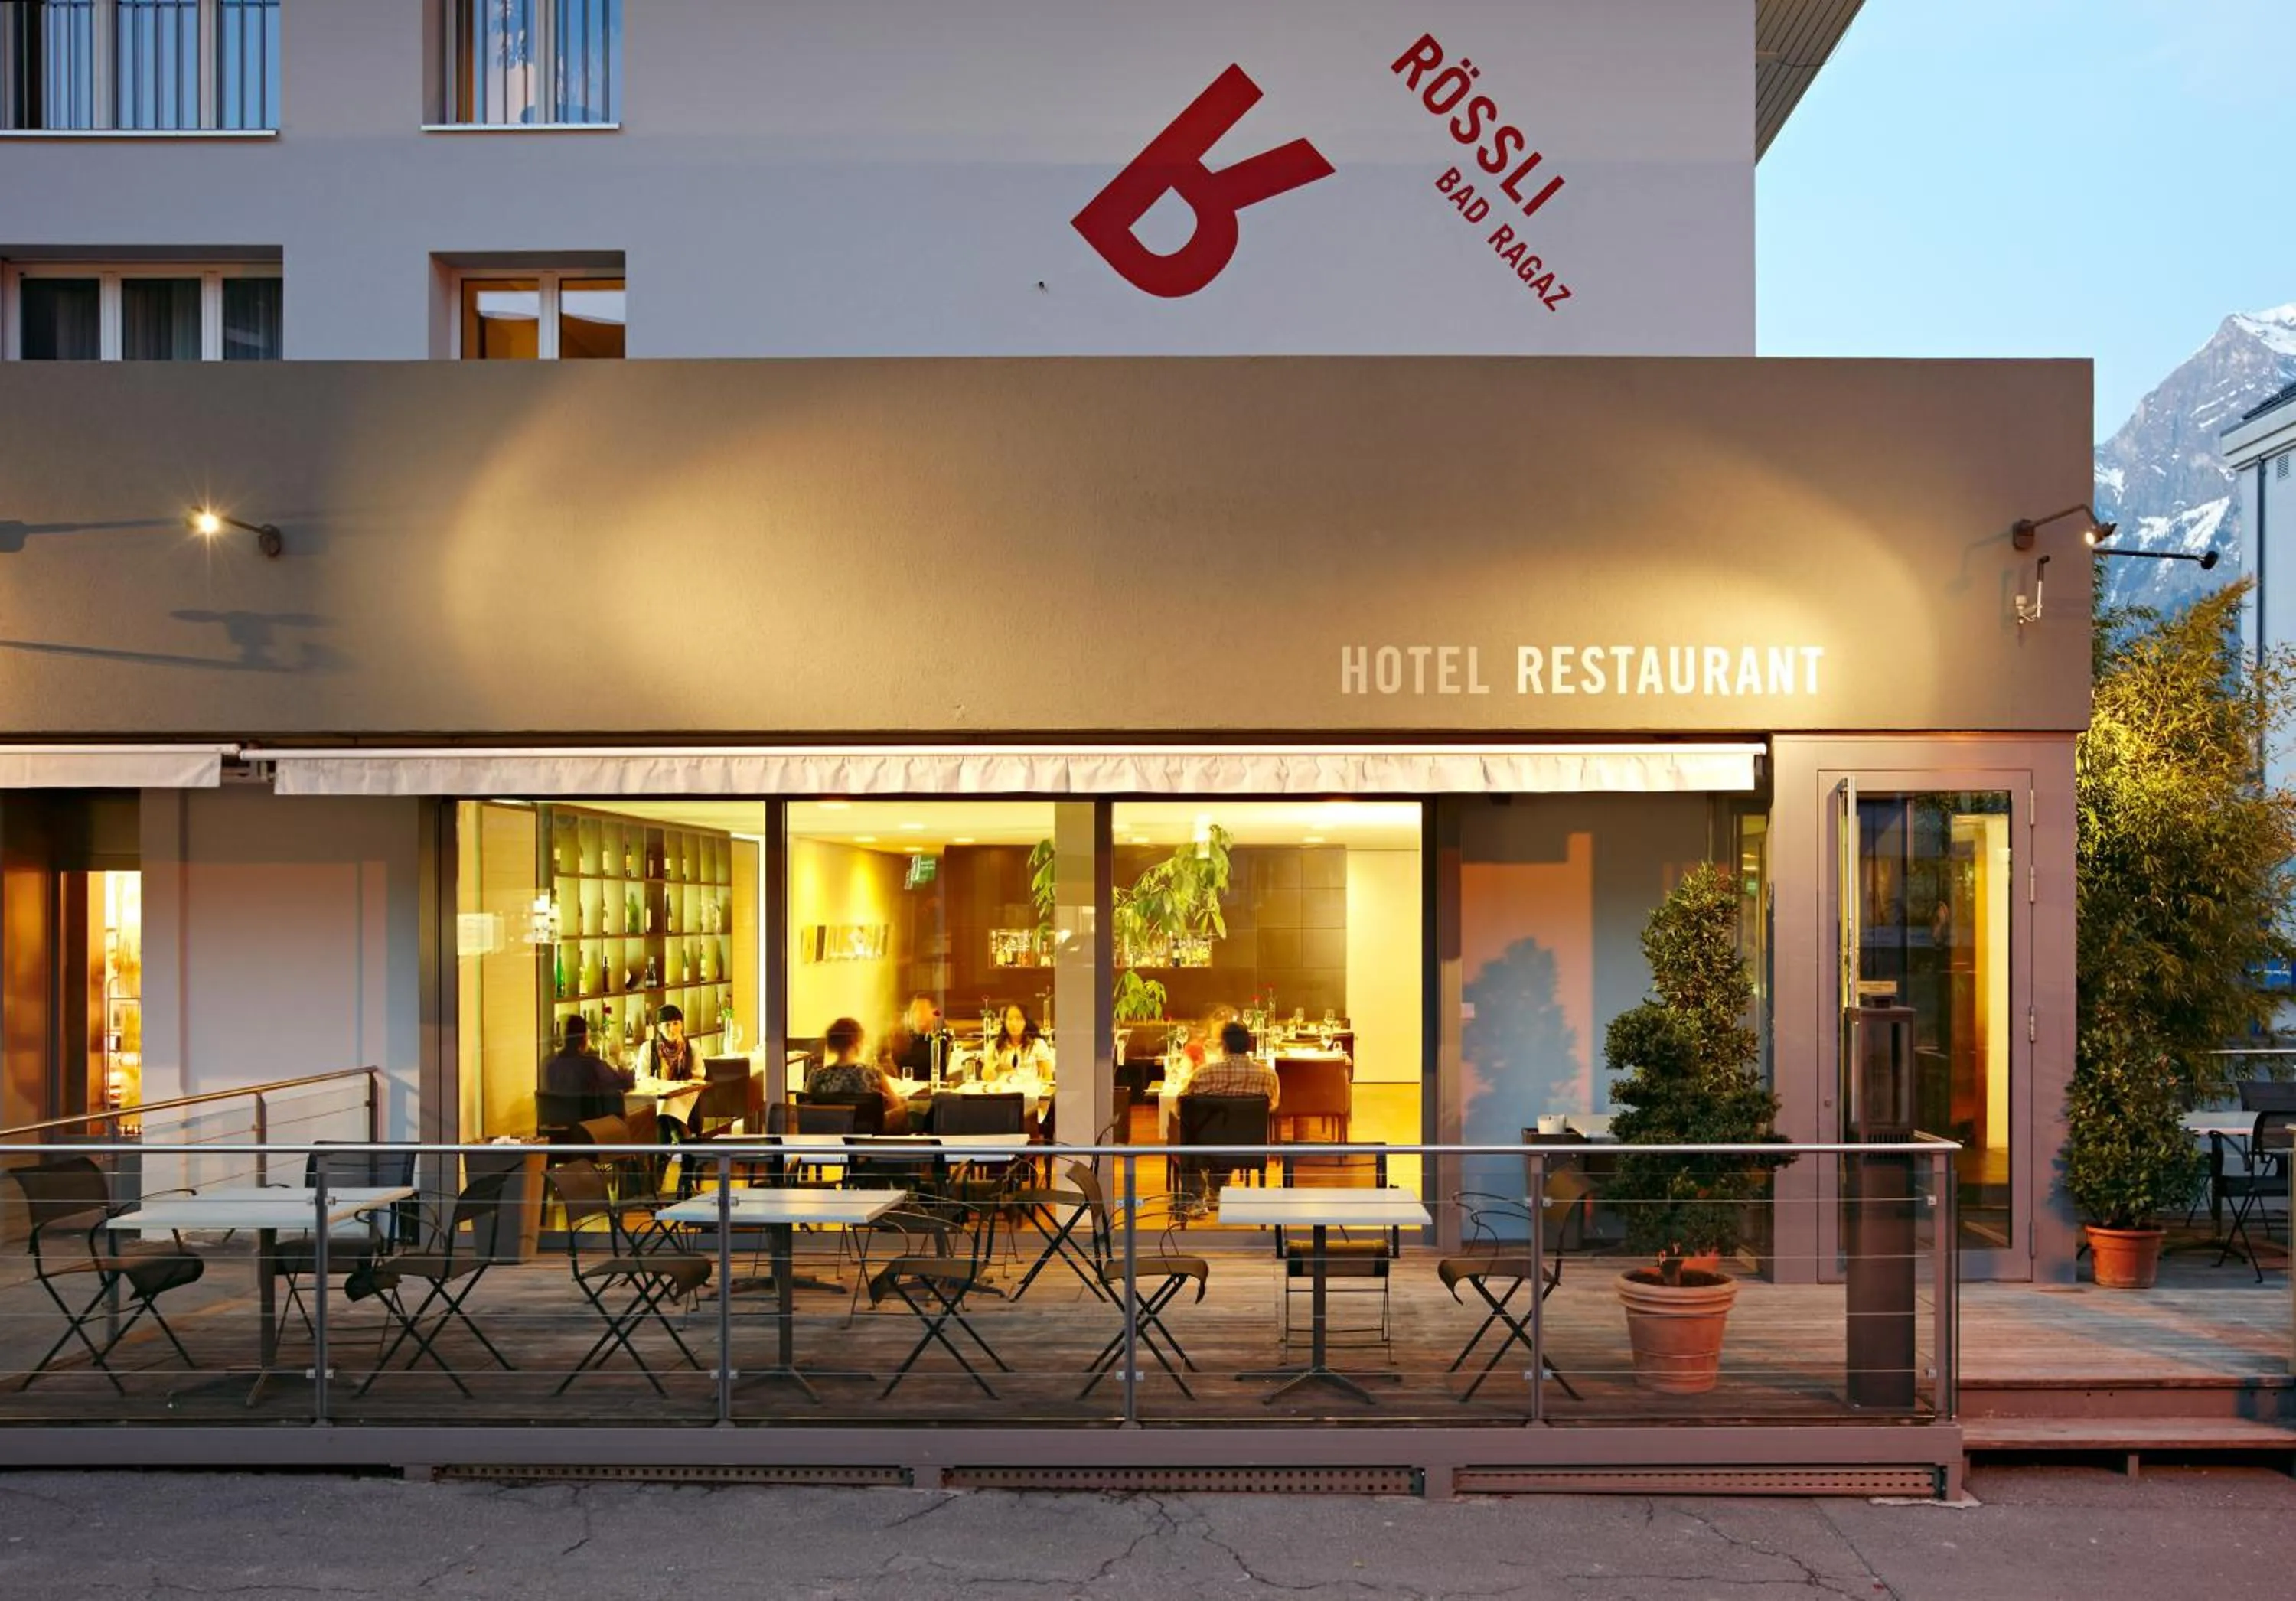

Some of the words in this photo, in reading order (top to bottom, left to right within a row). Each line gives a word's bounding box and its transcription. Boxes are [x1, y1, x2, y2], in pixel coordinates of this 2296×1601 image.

[1390, 32, 1565, 217] RÖSSLI
[1434, 166, 1491, 225] BAD
[1488, 223, 1573, 312] RAGAZ
[1341, 645, 1490, 695] HOTEL
[1516, 645, 1825, 696] RESTAURANT
